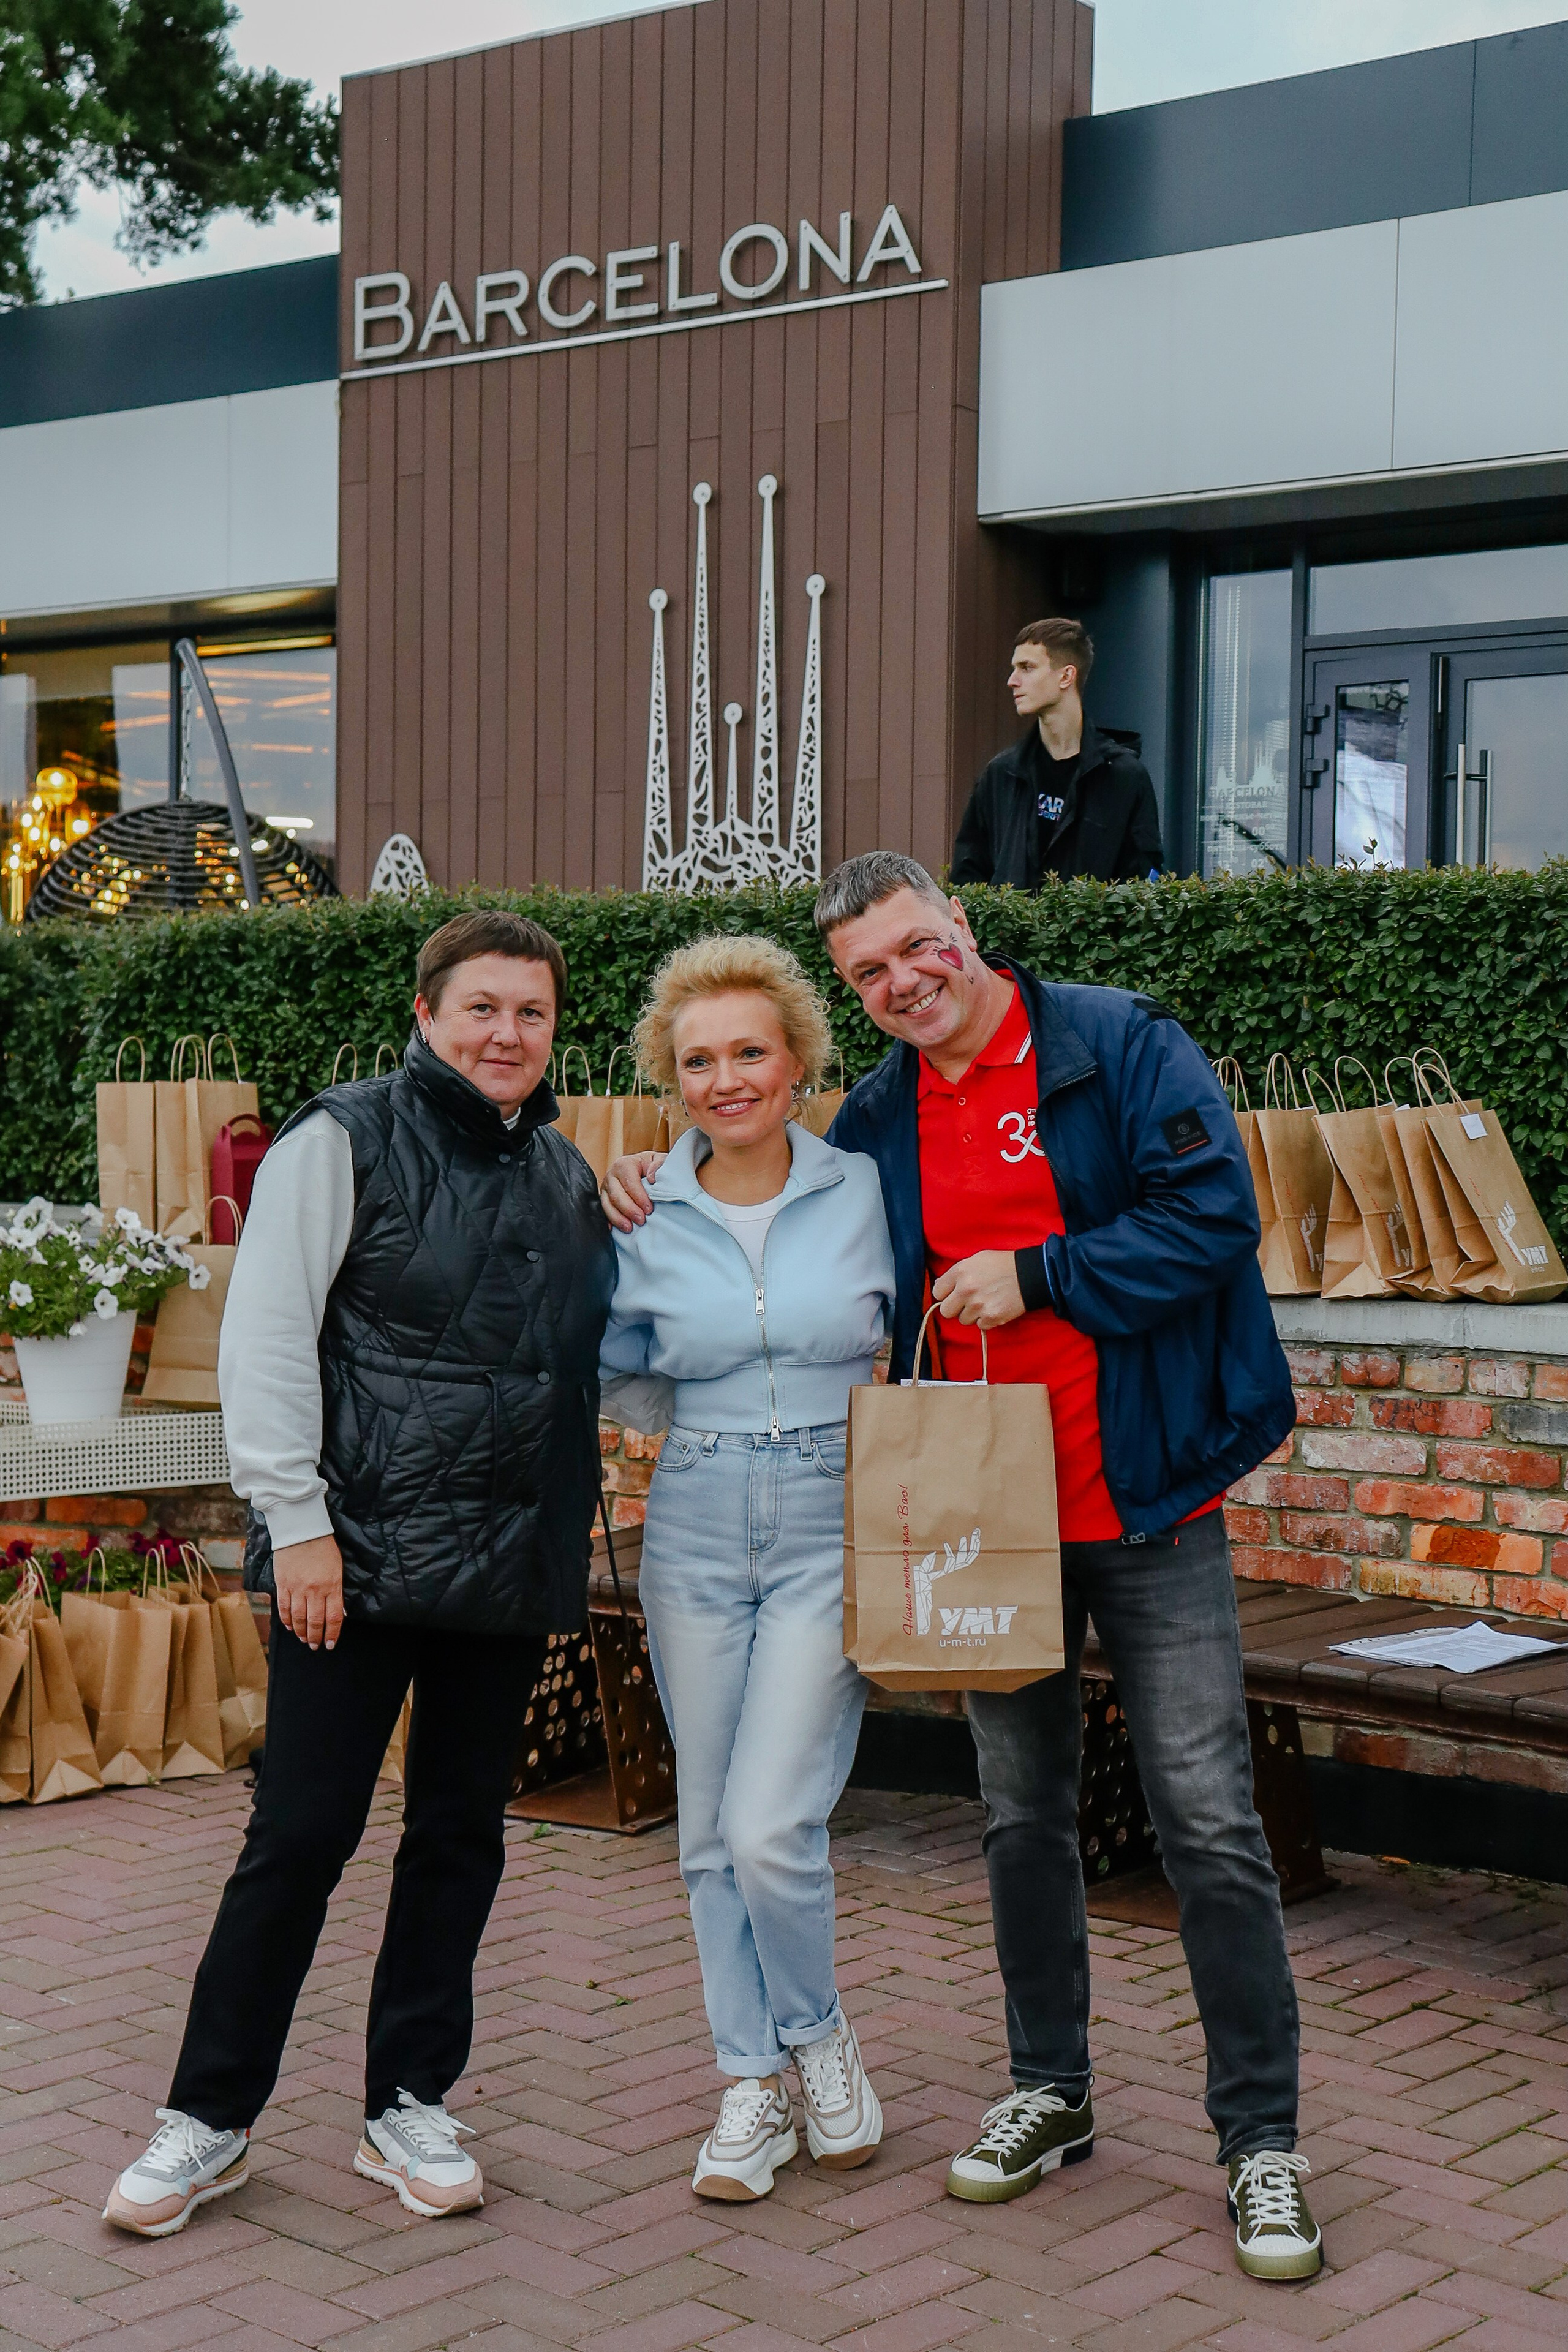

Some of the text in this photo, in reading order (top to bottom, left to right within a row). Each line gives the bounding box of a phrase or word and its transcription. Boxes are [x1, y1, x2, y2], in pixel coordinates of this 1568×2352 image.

[355, 203, 922, 361] BARCELONA
[897, 1483, 914, 1636] Наше тепло для Вас!
[938, 1605, 1019, 1636] УМТ
[938, 1637, 987, 1648] u-m-t.ru
